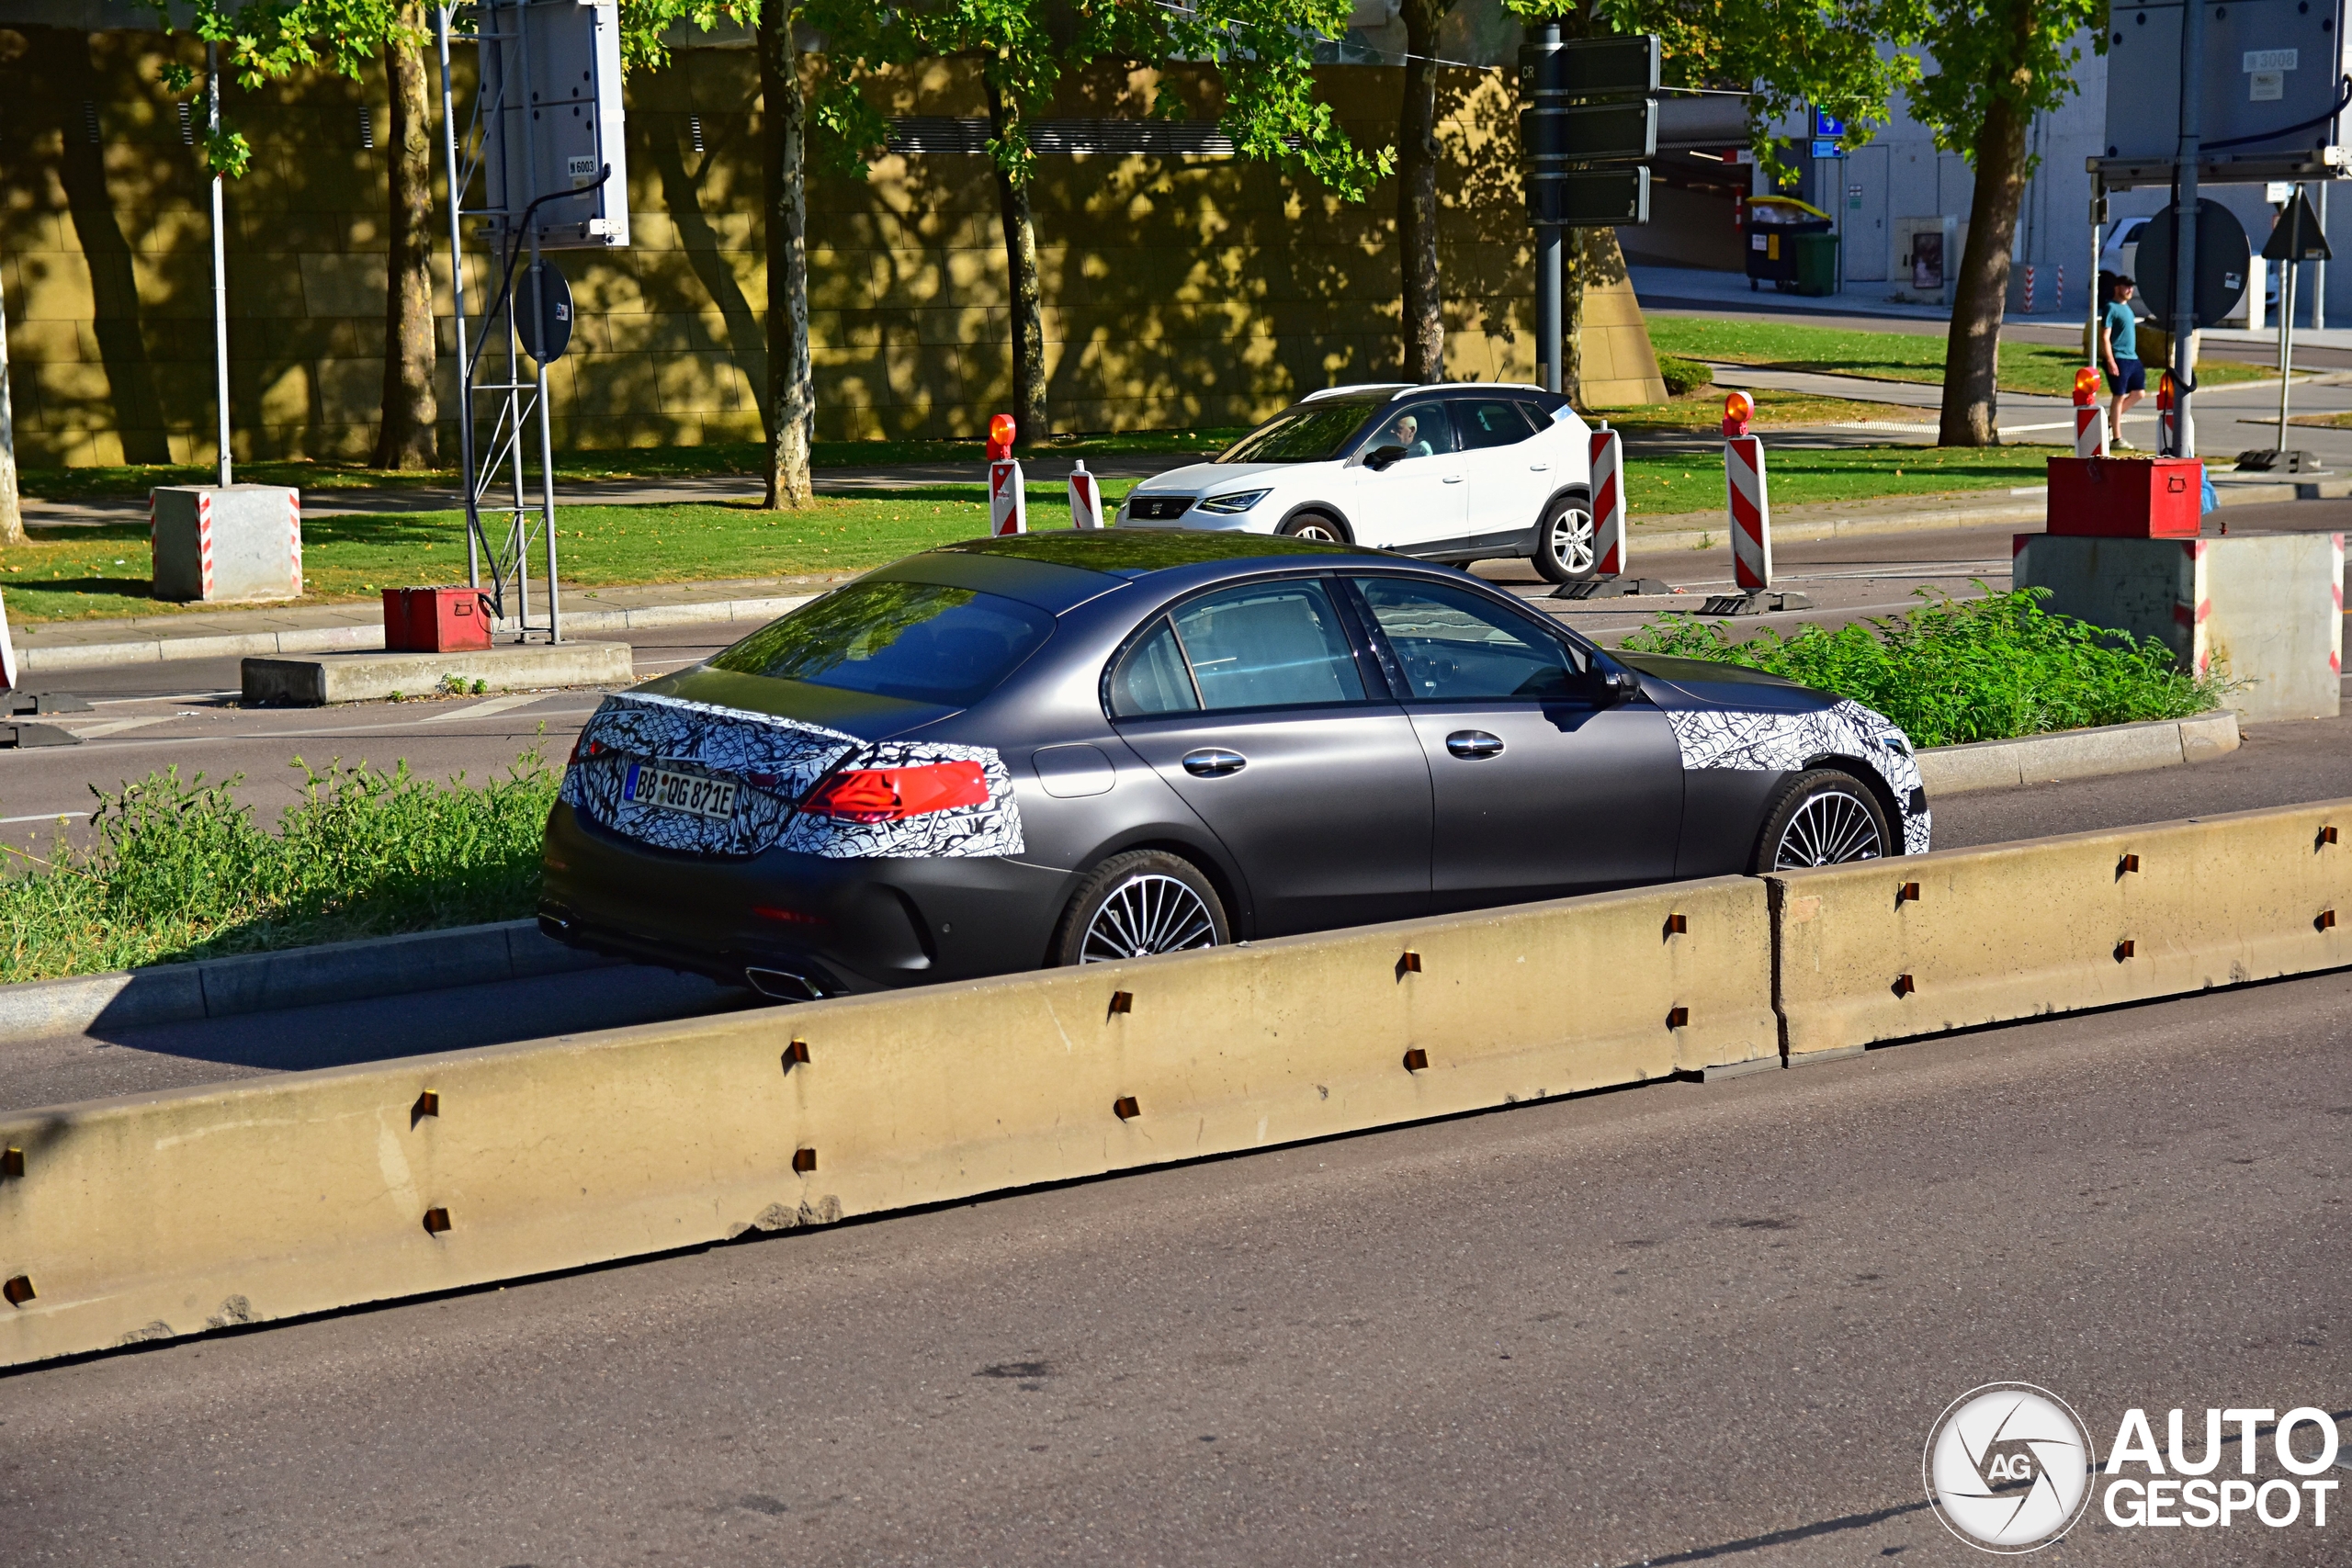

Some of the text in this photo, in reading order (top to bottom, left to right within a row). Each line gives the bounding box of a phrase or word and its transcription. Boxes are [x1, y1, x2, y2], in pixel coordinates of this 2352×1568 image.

[2260, 51, 2295, 68] 3008
[576, 161, 594, 173] 6003
[635, 770, 734, 815] BB QG 871E
